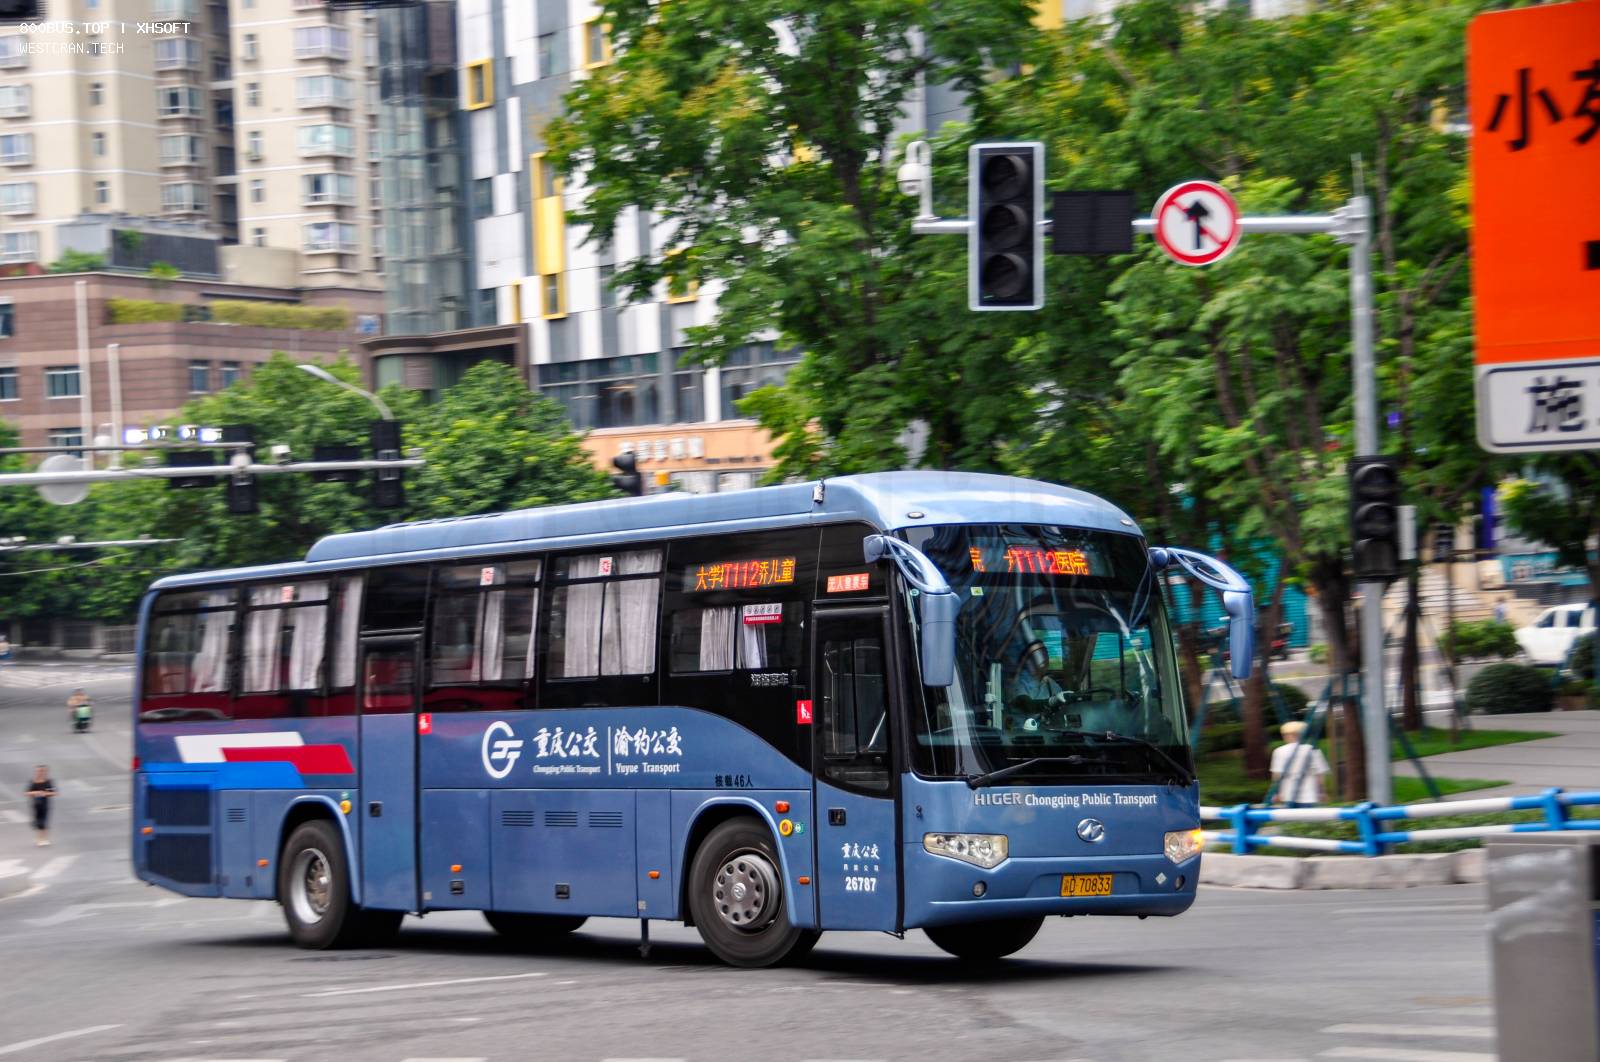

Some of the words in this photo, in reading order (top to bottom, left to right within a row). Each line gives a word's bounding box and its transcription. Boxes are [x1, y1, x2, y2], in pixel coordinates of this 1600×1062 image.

[1524, 374, 1600, 434] 施
[532, 726, 600, 758] 重庆公交
[615, 762, 639, 775] Yuyue
[641, 762, 681, 775] Transport
[974, 793, 1022, 806] HIGER
[1025, 793, 1080, 808] Chongqing
[1082, 793, 1112, 805] Public
[1114, 793, 1158, 807] Transport
[841, 842, 880, 860] 重庆公交
[845, 876, 877, 892] 26787
